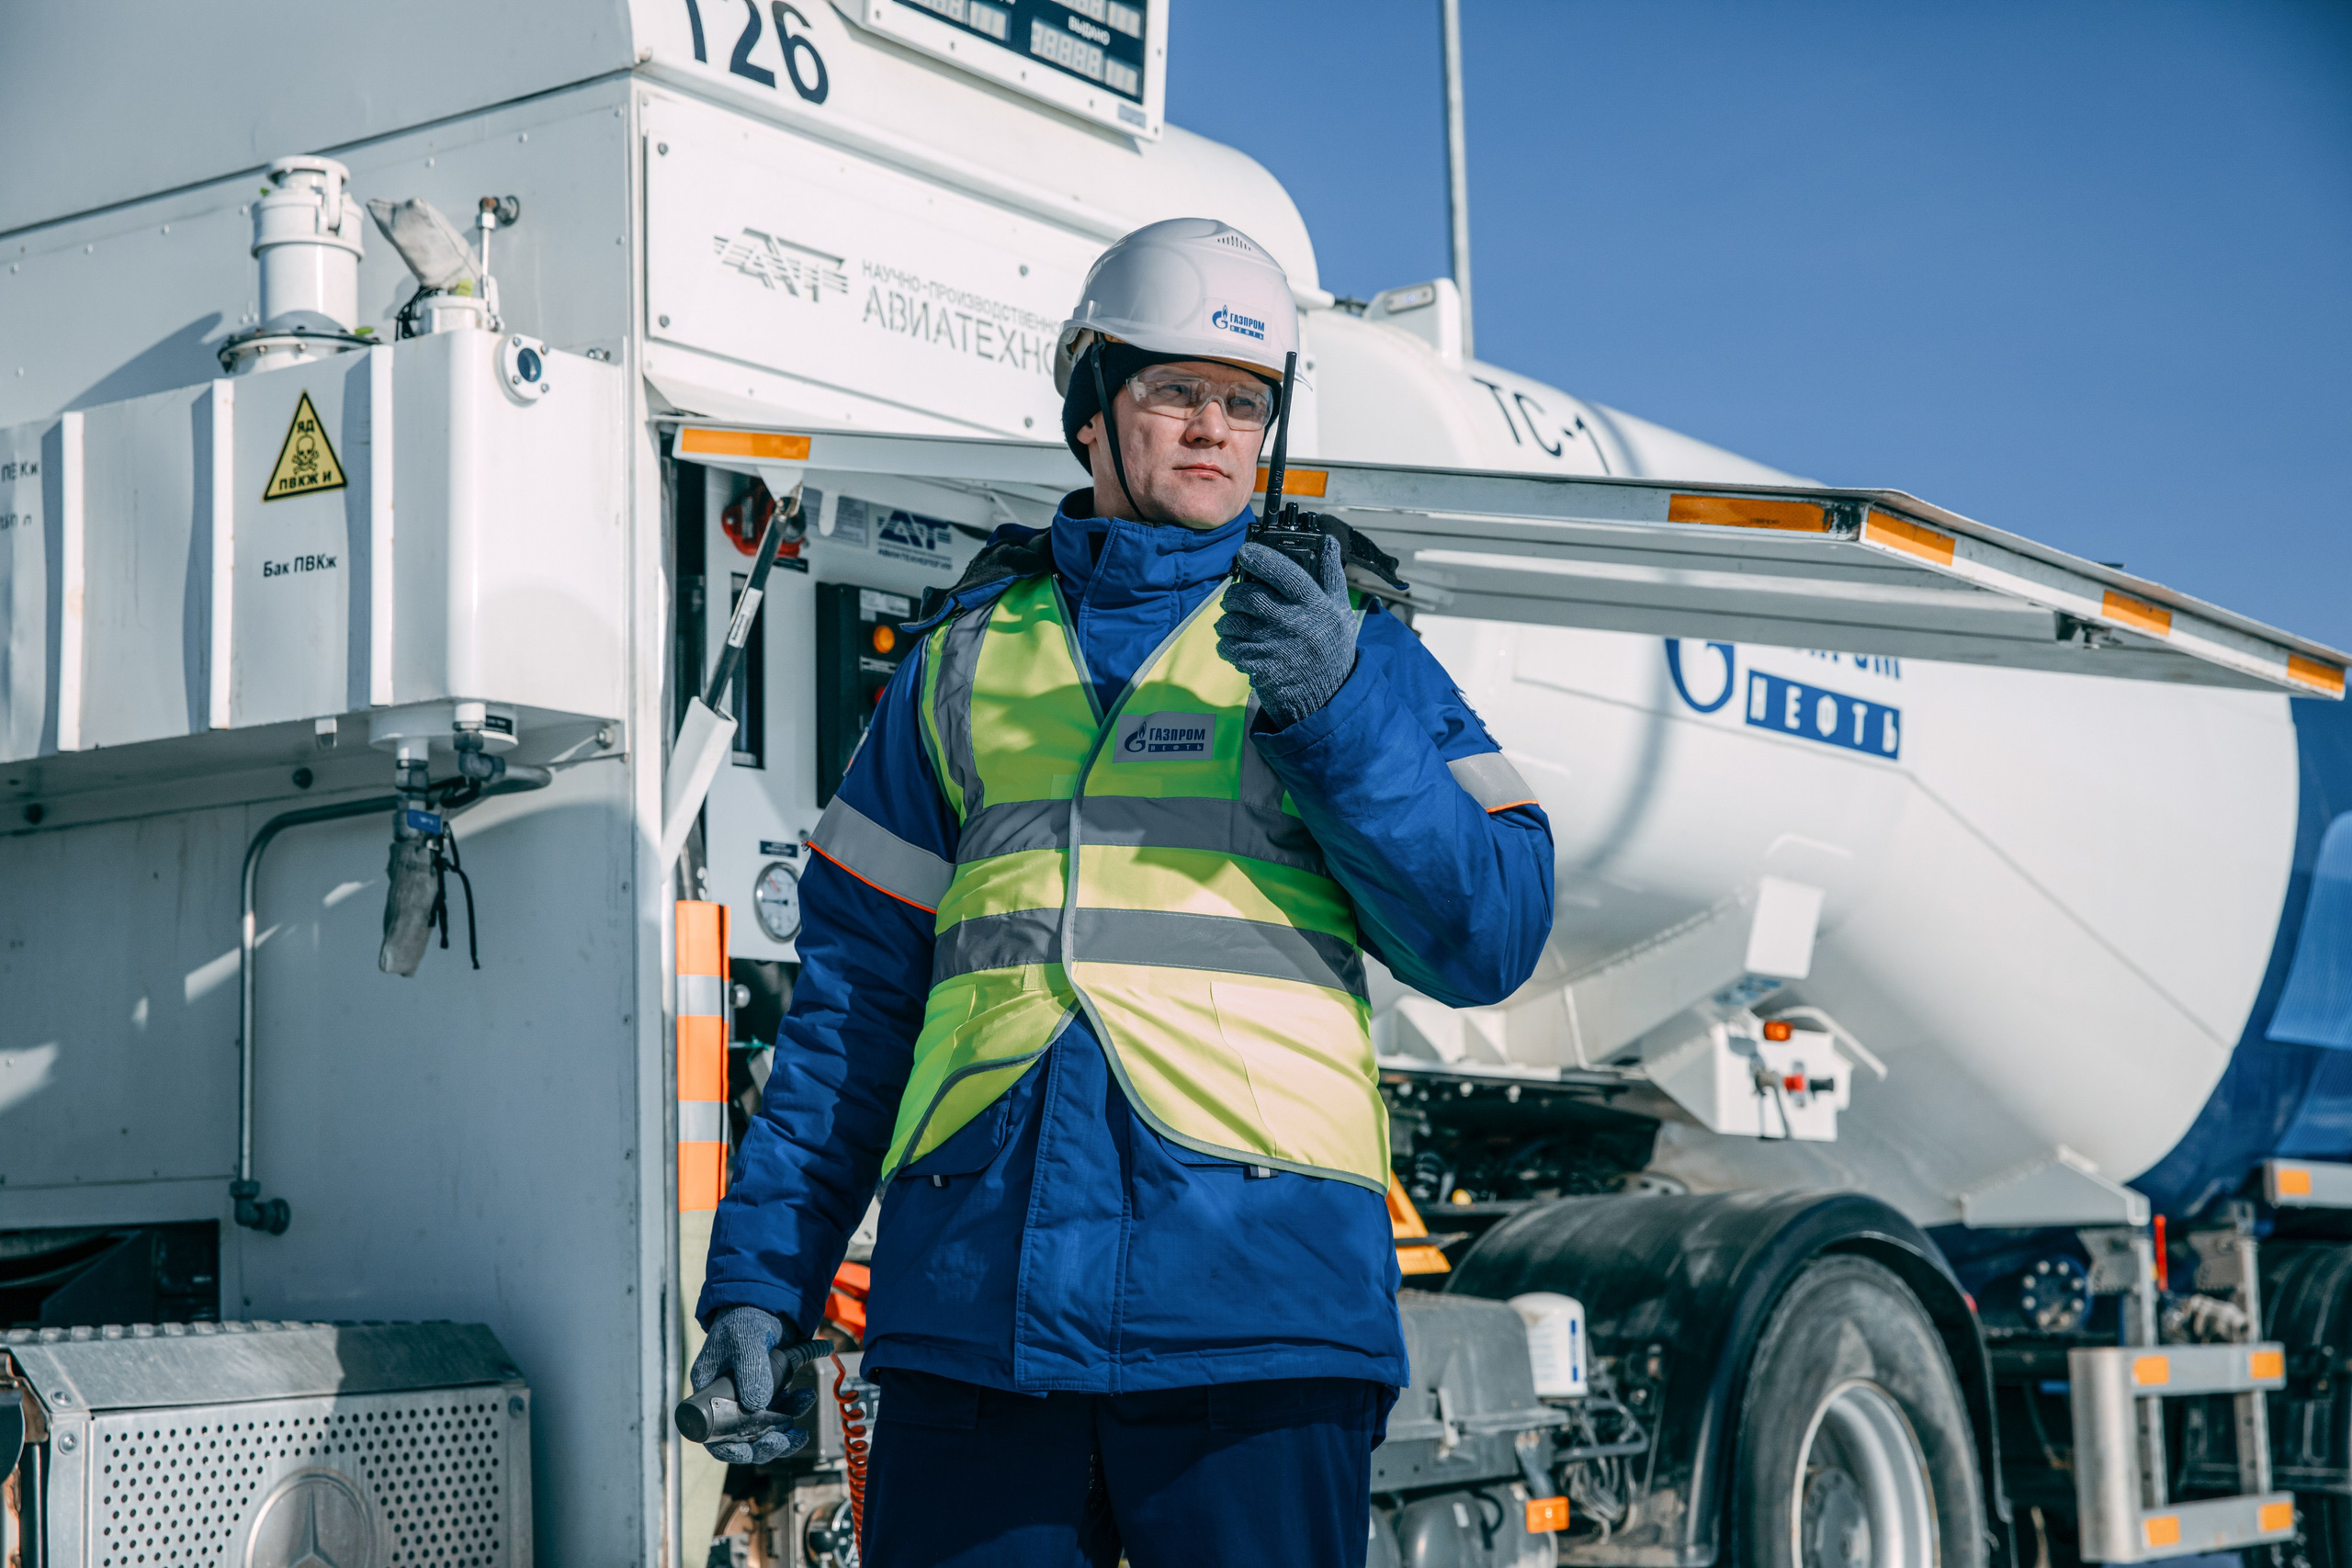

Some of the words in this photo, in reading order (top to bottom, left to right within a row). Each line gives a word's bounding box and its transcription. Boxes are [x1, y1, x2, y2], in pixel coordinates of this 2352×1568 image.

[1229, 313, 1265, 332] ГАЗПРОМ
[1231, 325, 1263, 340] НЕФТЬ
[298, 420, 315, 434] ЯД
[263, 560, 289, 578] Бак
[293, 554, 337, 573] ПВКж
[1149, 728, 1205, 741] ГАЗПРОМ
[1150, 743, 1202, 751] НЕФТЬ
